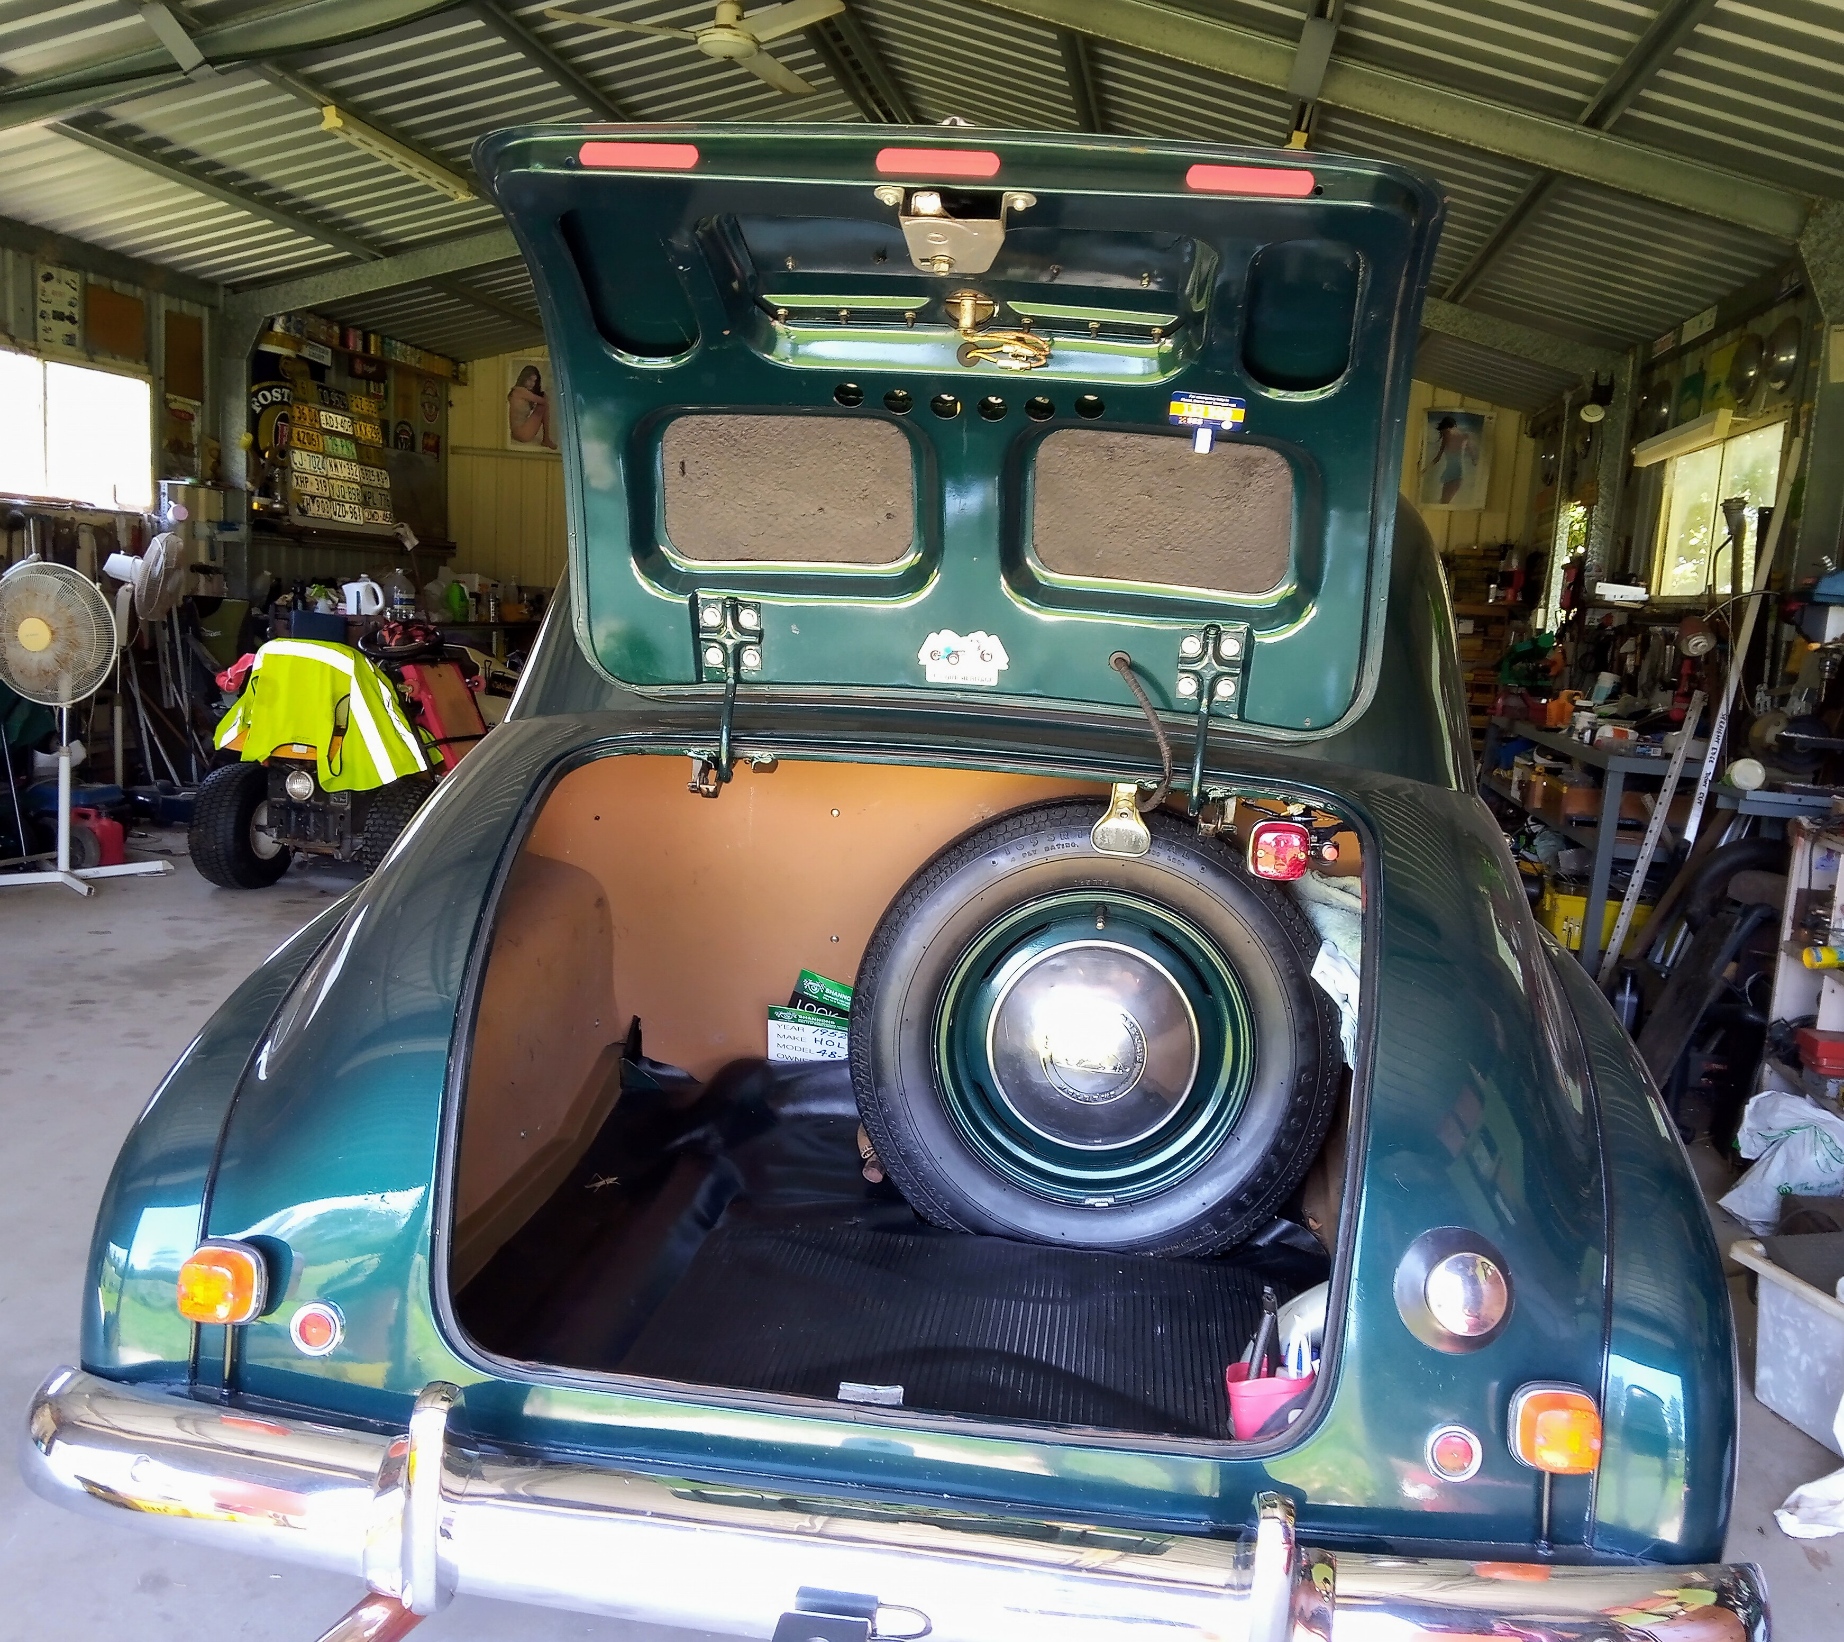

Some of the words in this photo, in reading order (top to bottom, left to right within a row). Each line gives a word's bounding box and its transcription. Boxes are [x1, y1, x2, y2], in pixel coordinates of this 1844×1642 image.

[251, 386, 293, 415] FOST
[776, 1023, 805, 1032] YEAR
[776, 1033, 806, 1042] MAKE
[776, 1043, 814, 1054] MODEL
